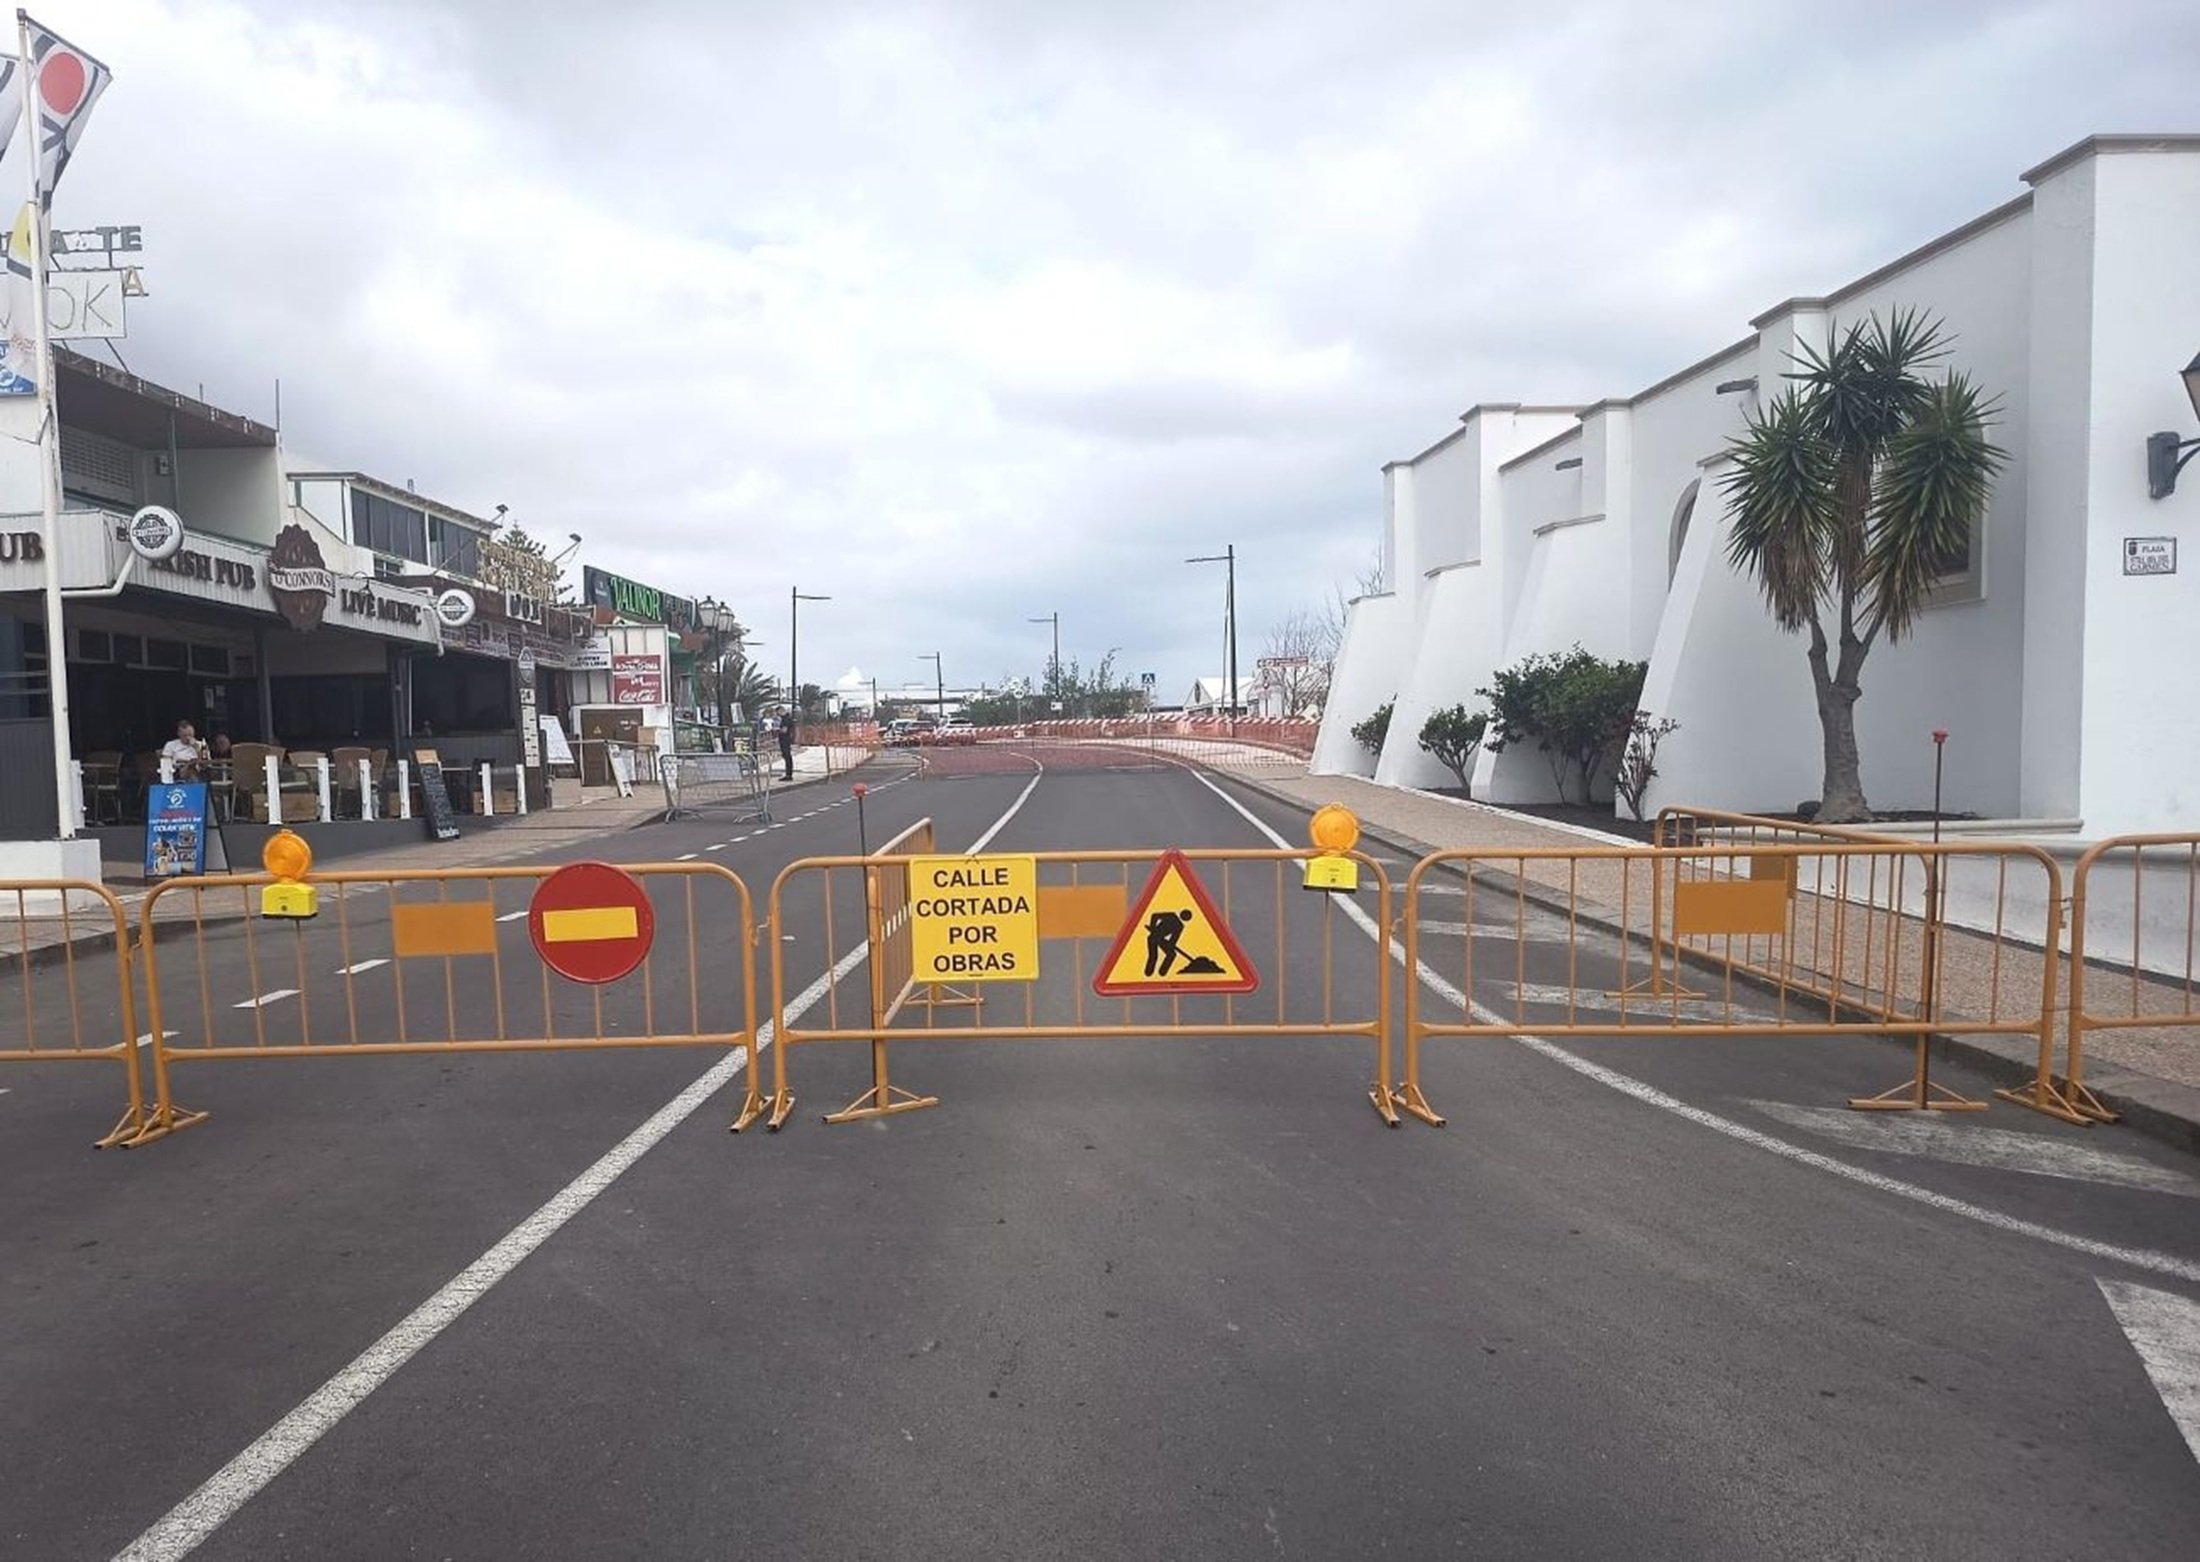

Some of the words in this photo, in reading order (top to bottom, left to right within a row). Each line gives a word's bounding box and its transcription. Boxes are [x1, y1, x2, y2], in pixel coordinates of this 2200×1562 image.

[214, 557, 257, 590] PUB
[273, 568, 331, 590] O'CONNORS
[341, 588, 376, 617] LIVE
[376, 597, 422, 626] MUSIC
[610, 577, 662, 622] VALINOR
[933, 868, 1009, 888] CALLE
[916, 896, 1030, 917] CORTADA
[949, 925, 997, 944] POR
[933, 952, 1015, 973] OBRAS
